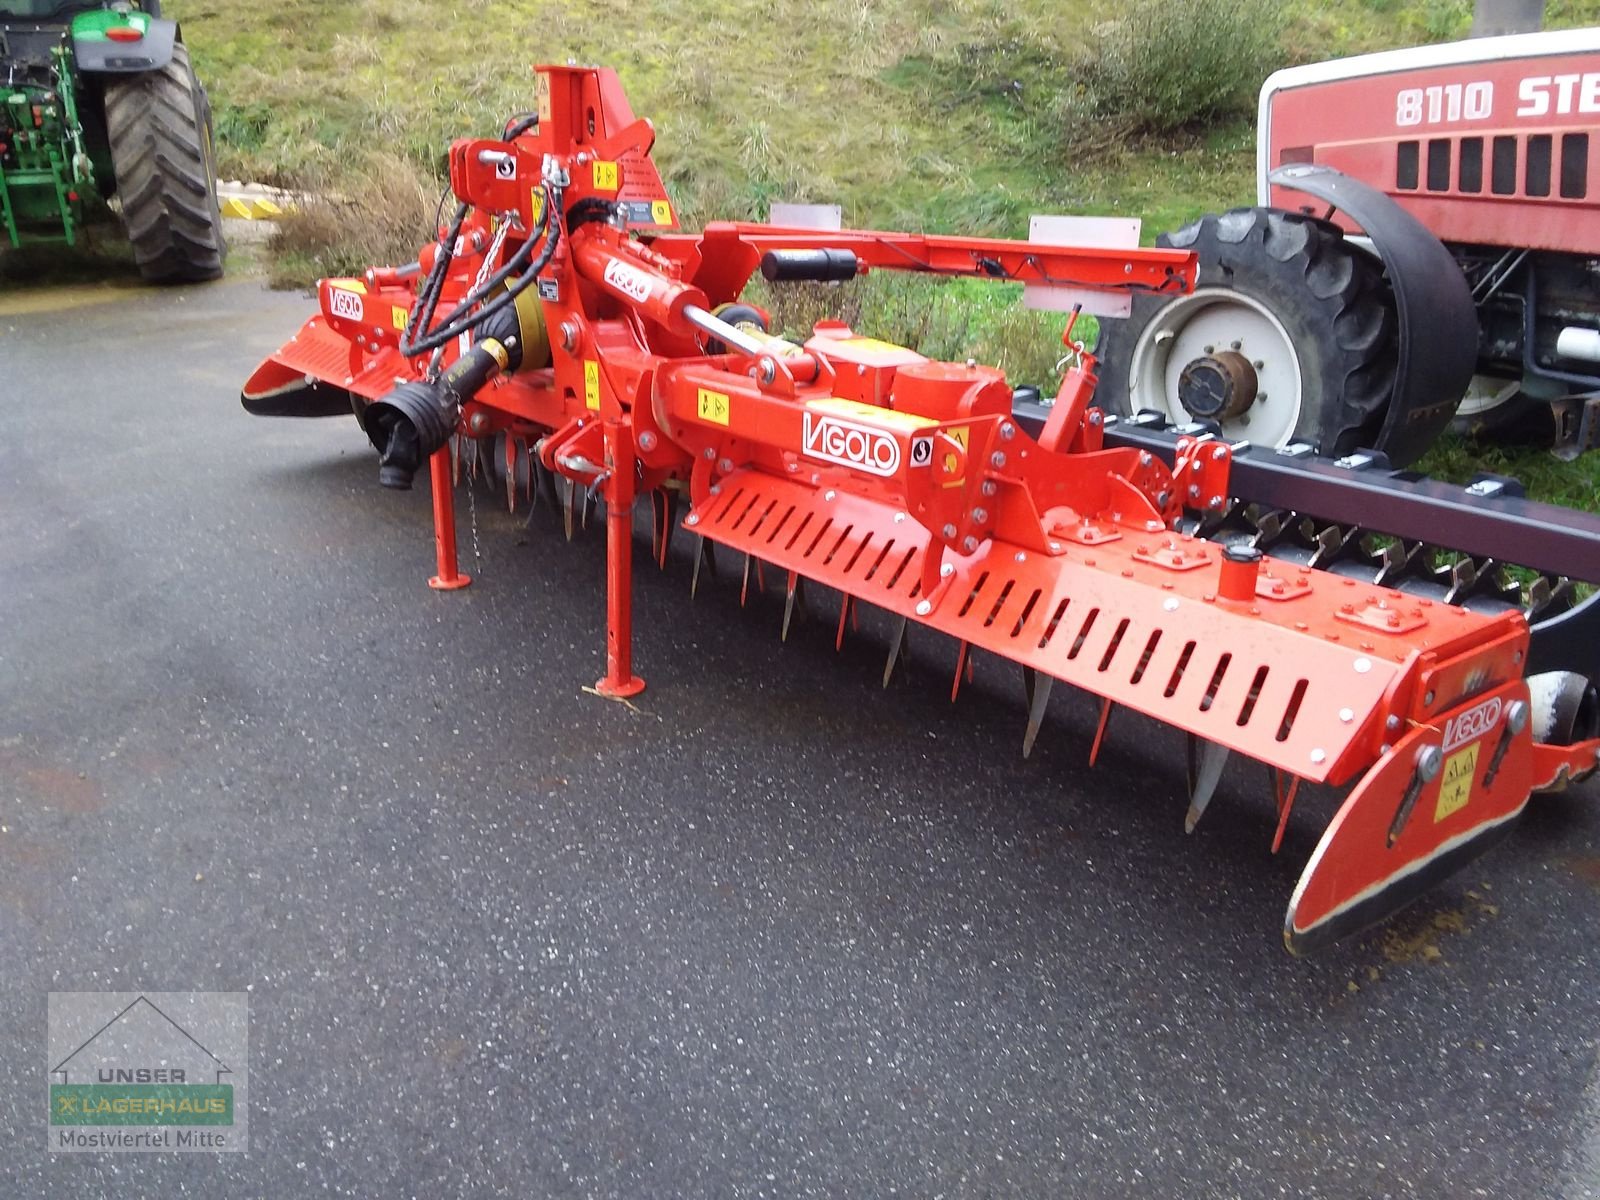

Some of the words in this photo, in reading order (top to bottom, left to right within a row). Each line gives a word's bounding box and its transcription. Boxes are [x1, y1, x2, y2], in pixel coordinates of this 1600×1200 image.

[1396, 80, 1494, 126] 8110
[329, 287, 363, 321] VIGOLO
[803, 411, 899, 475] VIGOLO
[1442, 697, 1502, 752] VIGOLO
